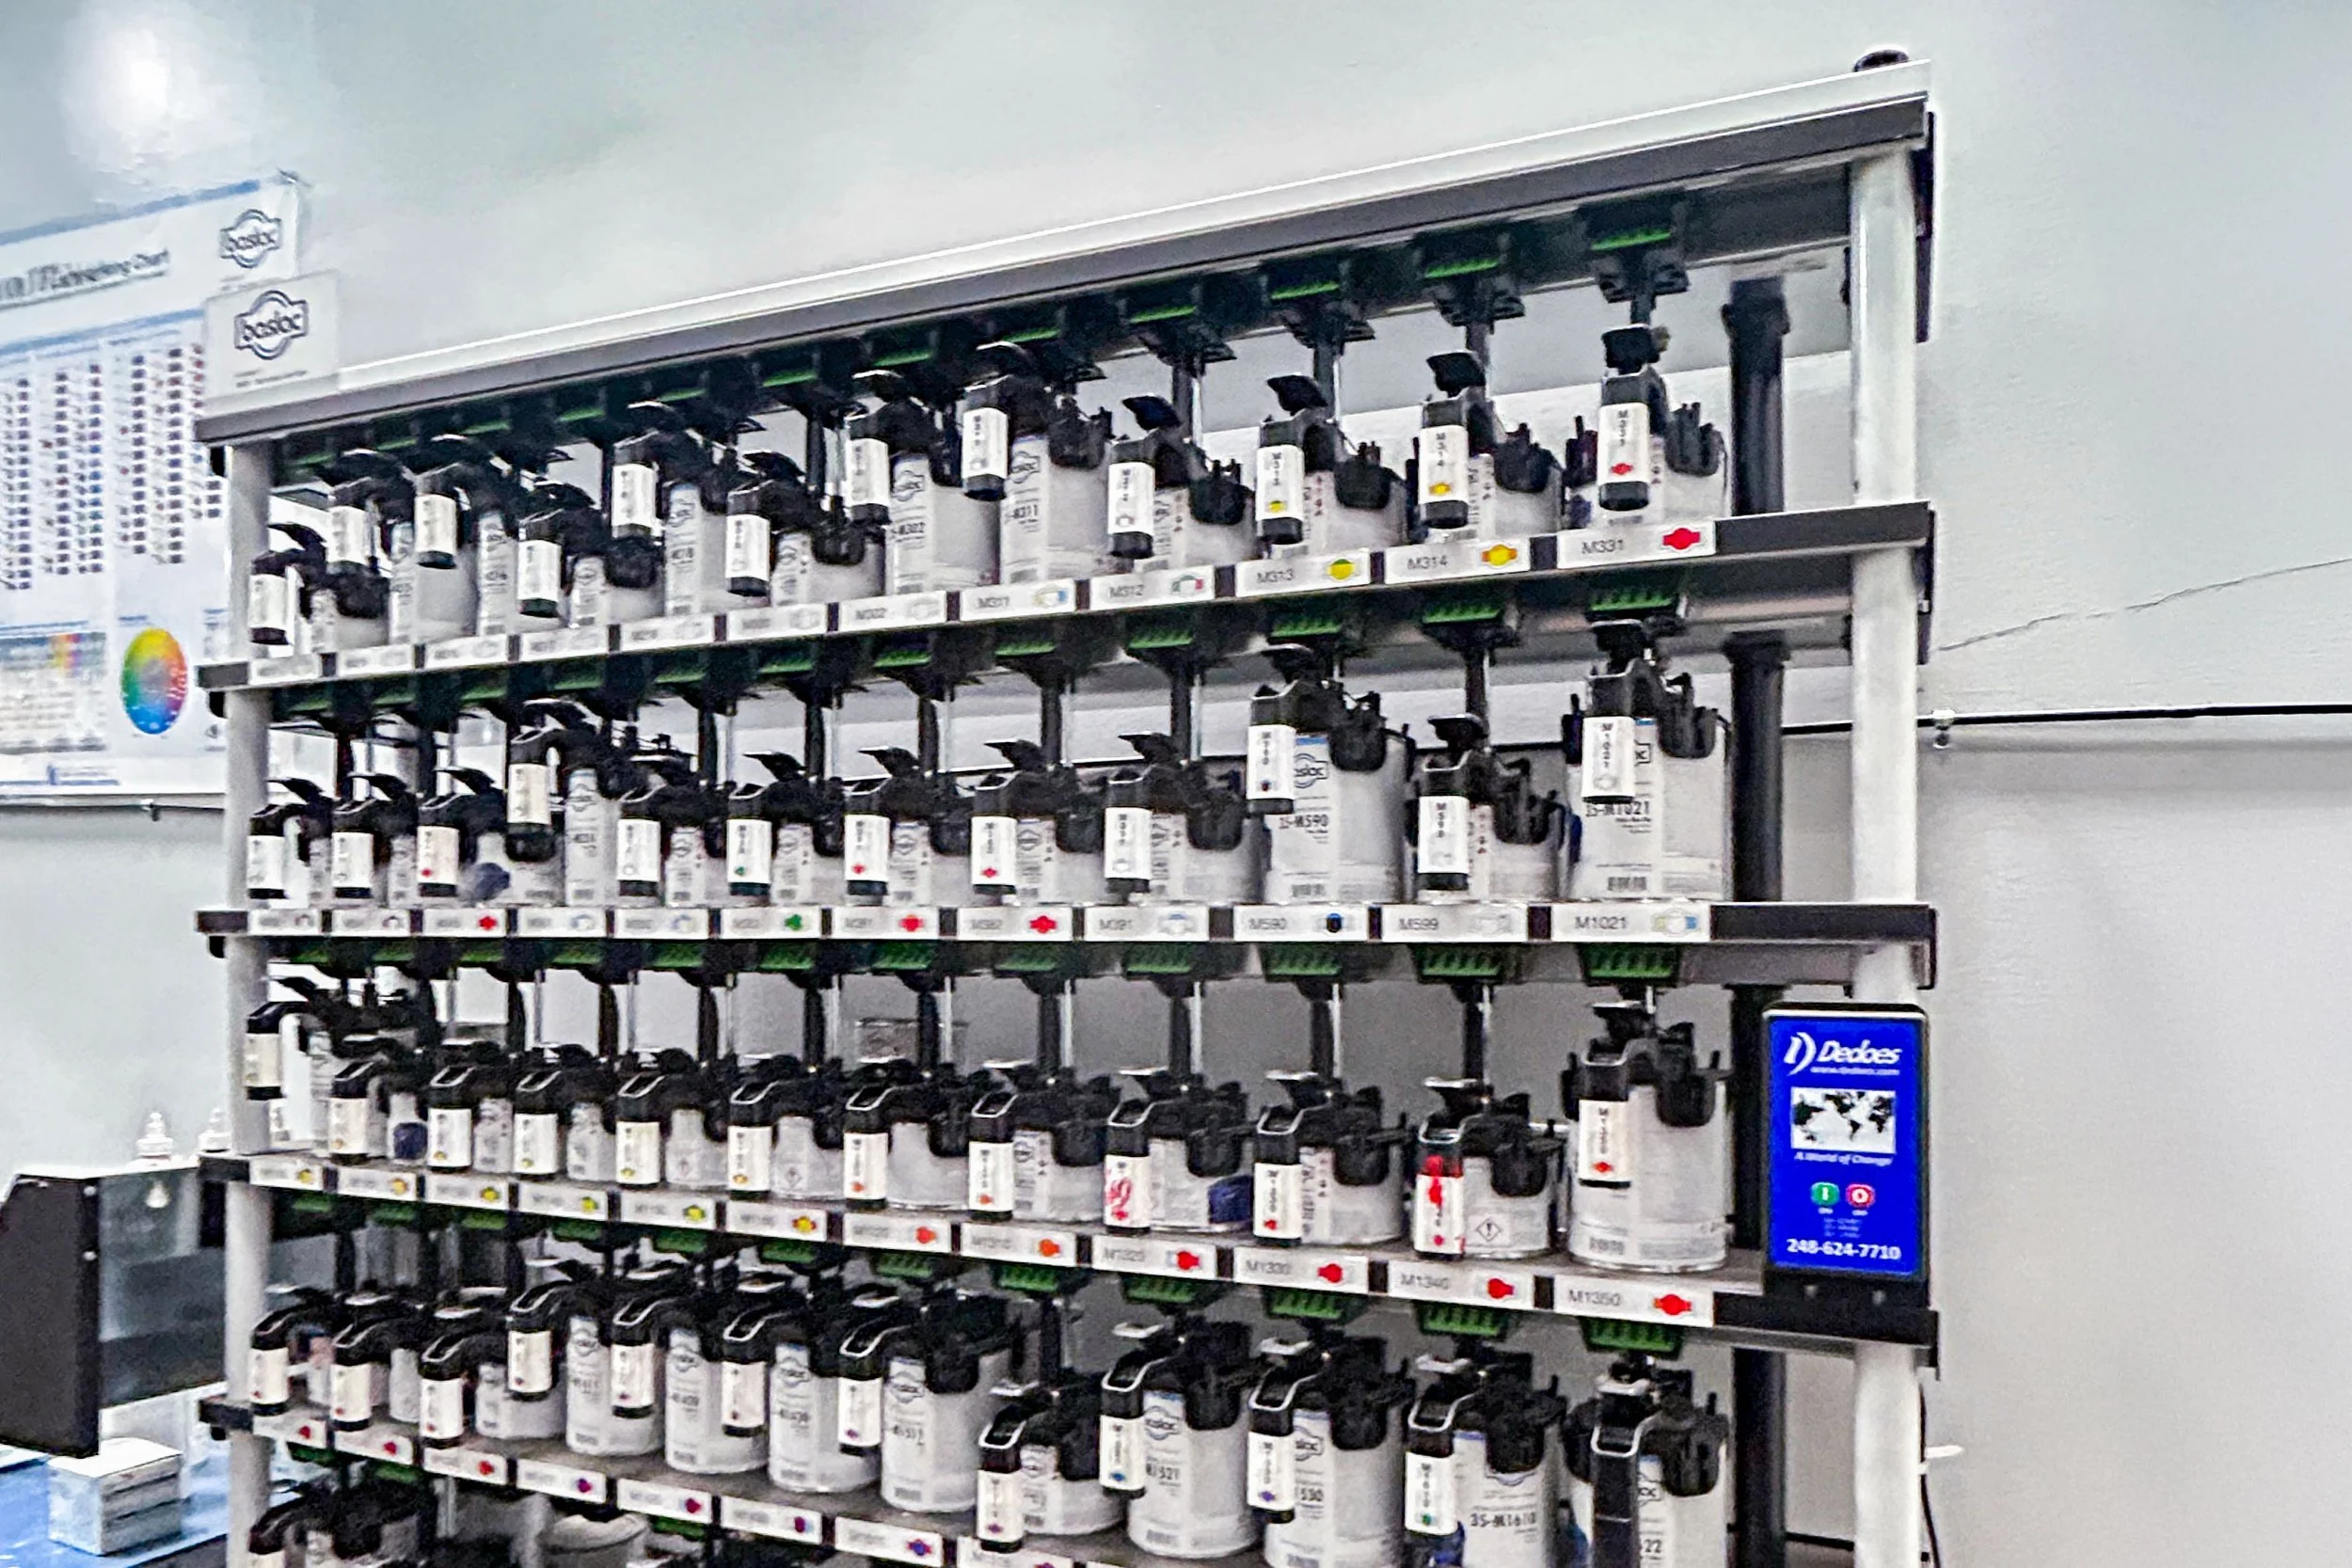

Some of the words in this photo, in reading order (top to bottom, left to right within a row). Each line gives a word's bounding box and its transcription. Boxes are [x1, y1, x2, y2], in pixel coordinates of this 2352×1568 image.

[1581, 538, 1624, 555] M331
[1406, 554, 1449, 570] M314
[1398, 917, 1439, 931] M599
[1574, 914, 1629, 929] M1021
[1816, 1038, 1903, 1065] Dedoes
[1786, 1239, 1902, 1260] 248-624-7710
[1568, 1289, 1620, 1307] M1350
